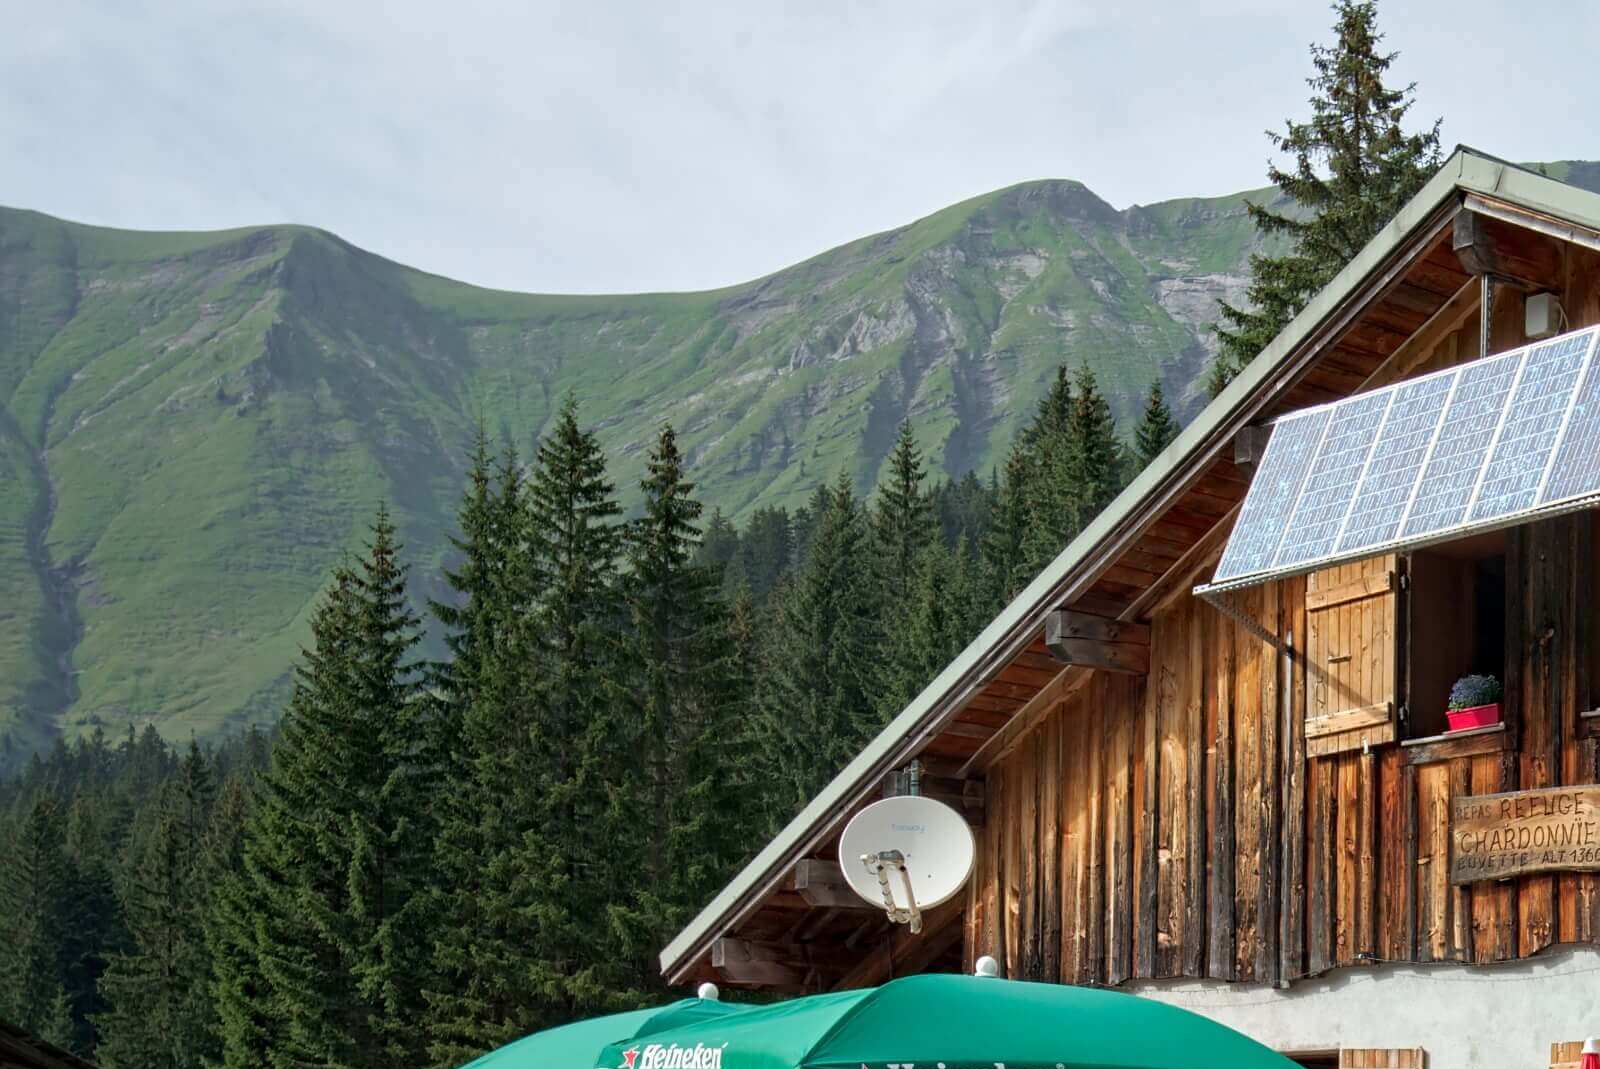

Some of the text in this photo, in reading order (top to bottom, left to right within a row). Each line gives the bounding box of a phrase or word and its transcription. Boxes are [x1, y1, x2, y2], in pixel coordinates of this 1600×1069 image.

[1456, 805, 1491, 821] REPAS
[1500, 791, 1585, 820] REFUGE
[1457, 852, 1529, 871] BUVETTE
